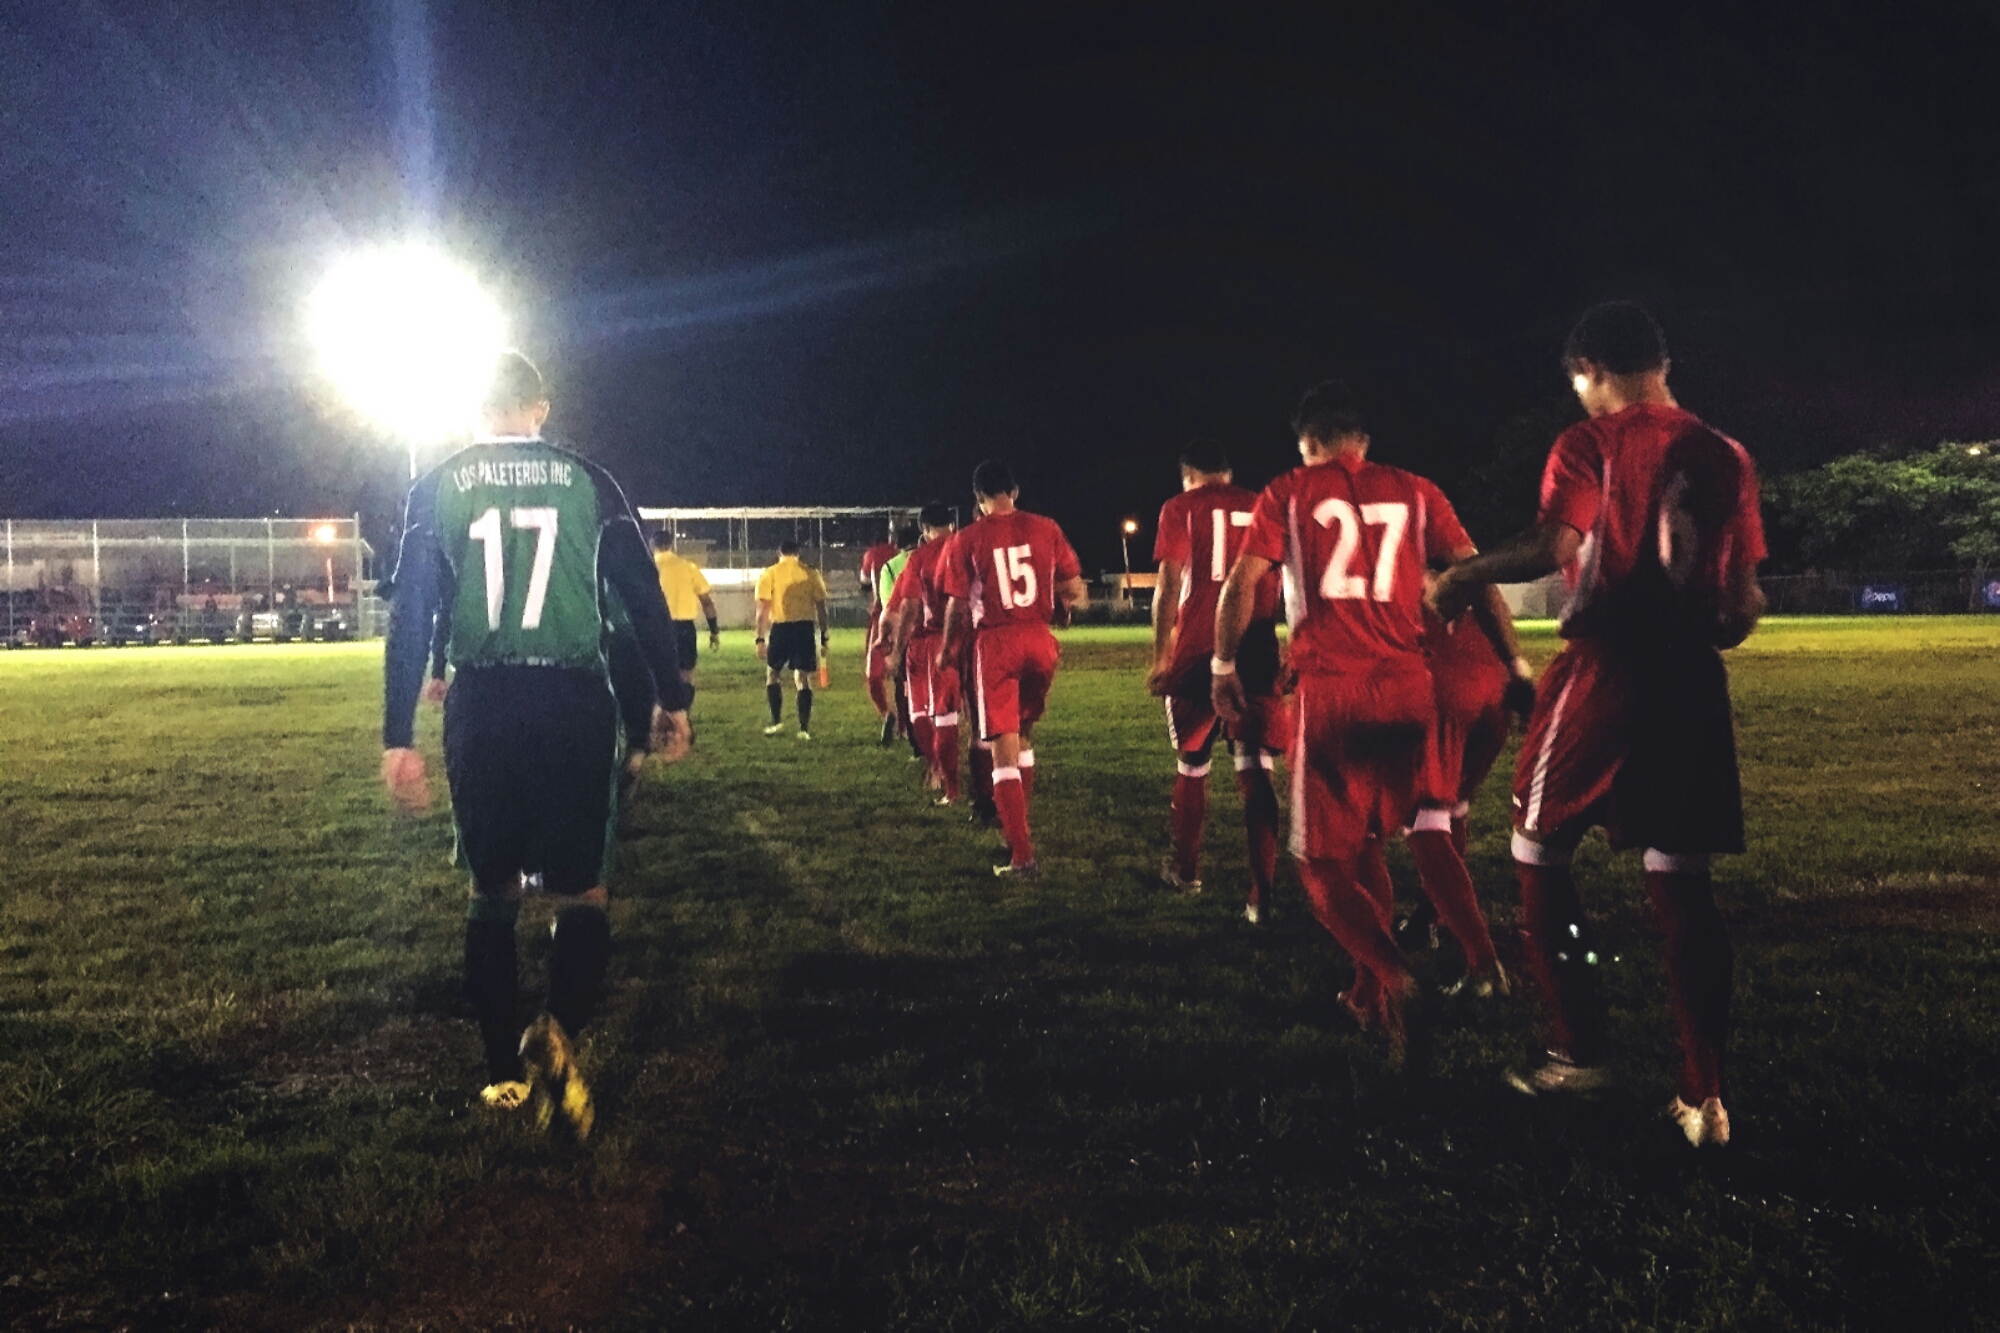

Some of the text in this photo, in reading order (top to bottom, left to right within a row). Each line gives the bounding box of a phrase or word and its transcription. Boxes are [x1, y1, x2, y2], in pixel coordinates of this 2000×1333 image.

[453, 459, 572, 492] LOS PALETEROS INC
[469, 508, 558, 631] 17
[993, 544, 1038, 609] 15
[1313, 498, 1408, 602] 27
